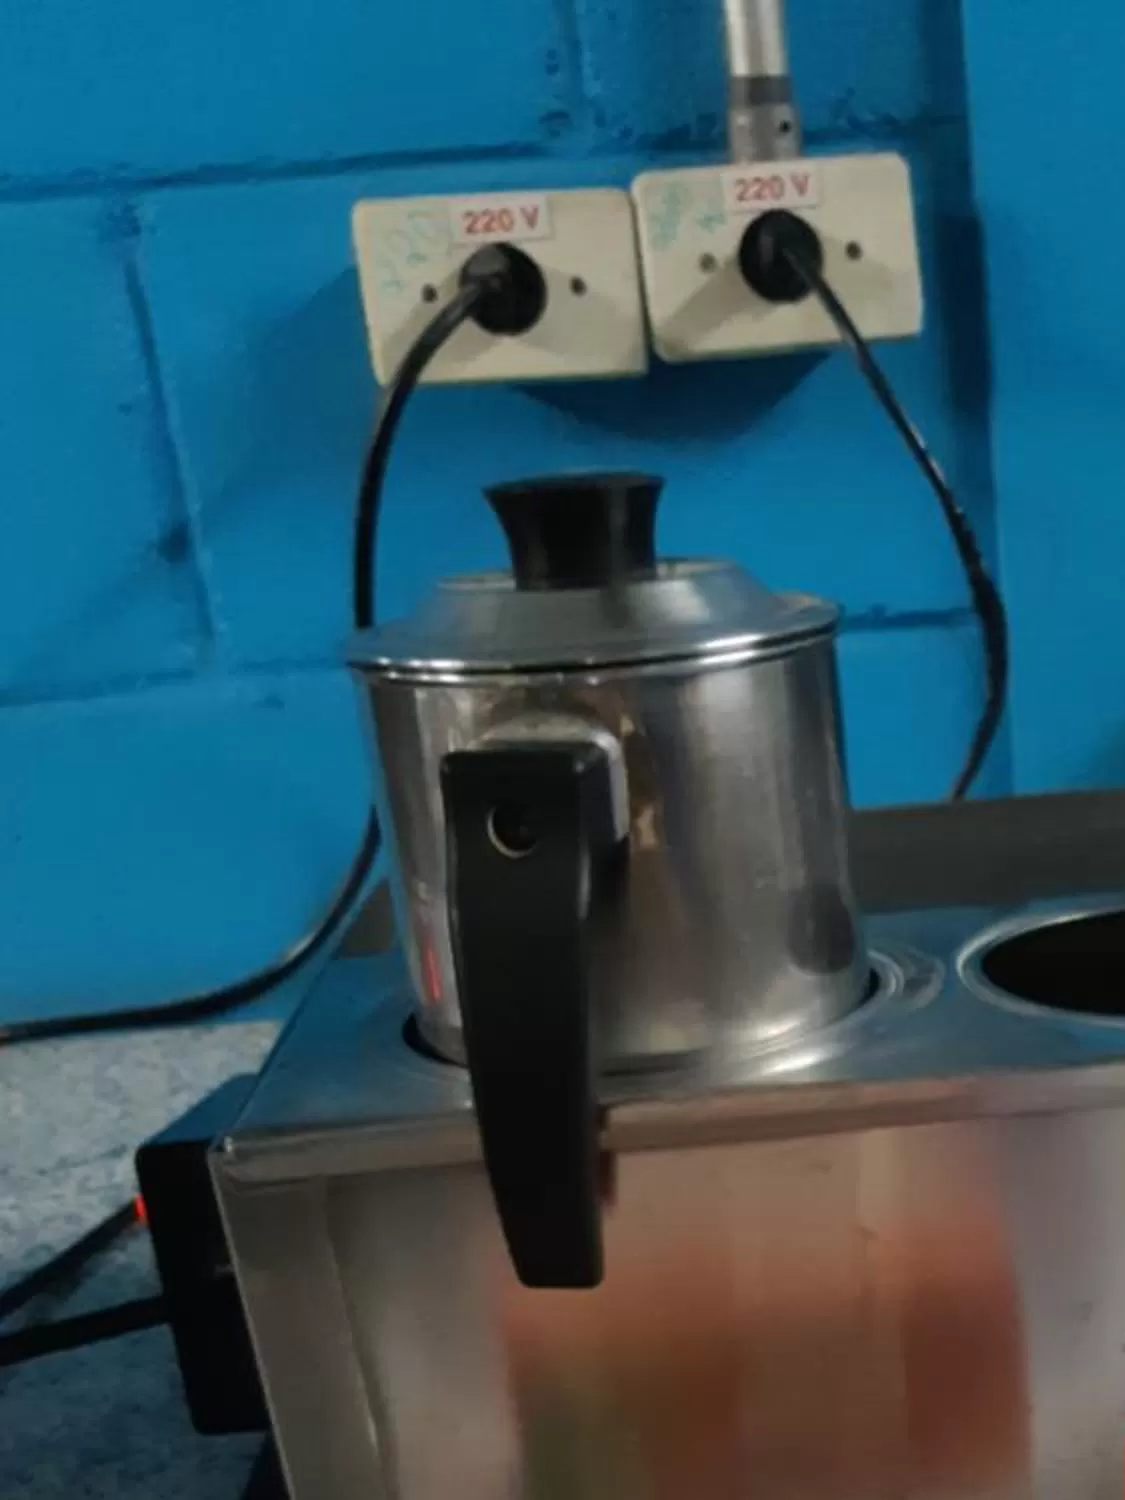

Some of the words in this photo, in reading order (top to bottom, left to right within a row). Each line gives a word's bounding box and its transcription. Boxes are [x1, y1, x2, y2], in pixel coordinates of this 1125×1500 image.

[734, 174, 784, 203] 220
[789, 172, 812, 197] V
[462, 207, 515, 235] 220
[520, 204, 540, 230] V
